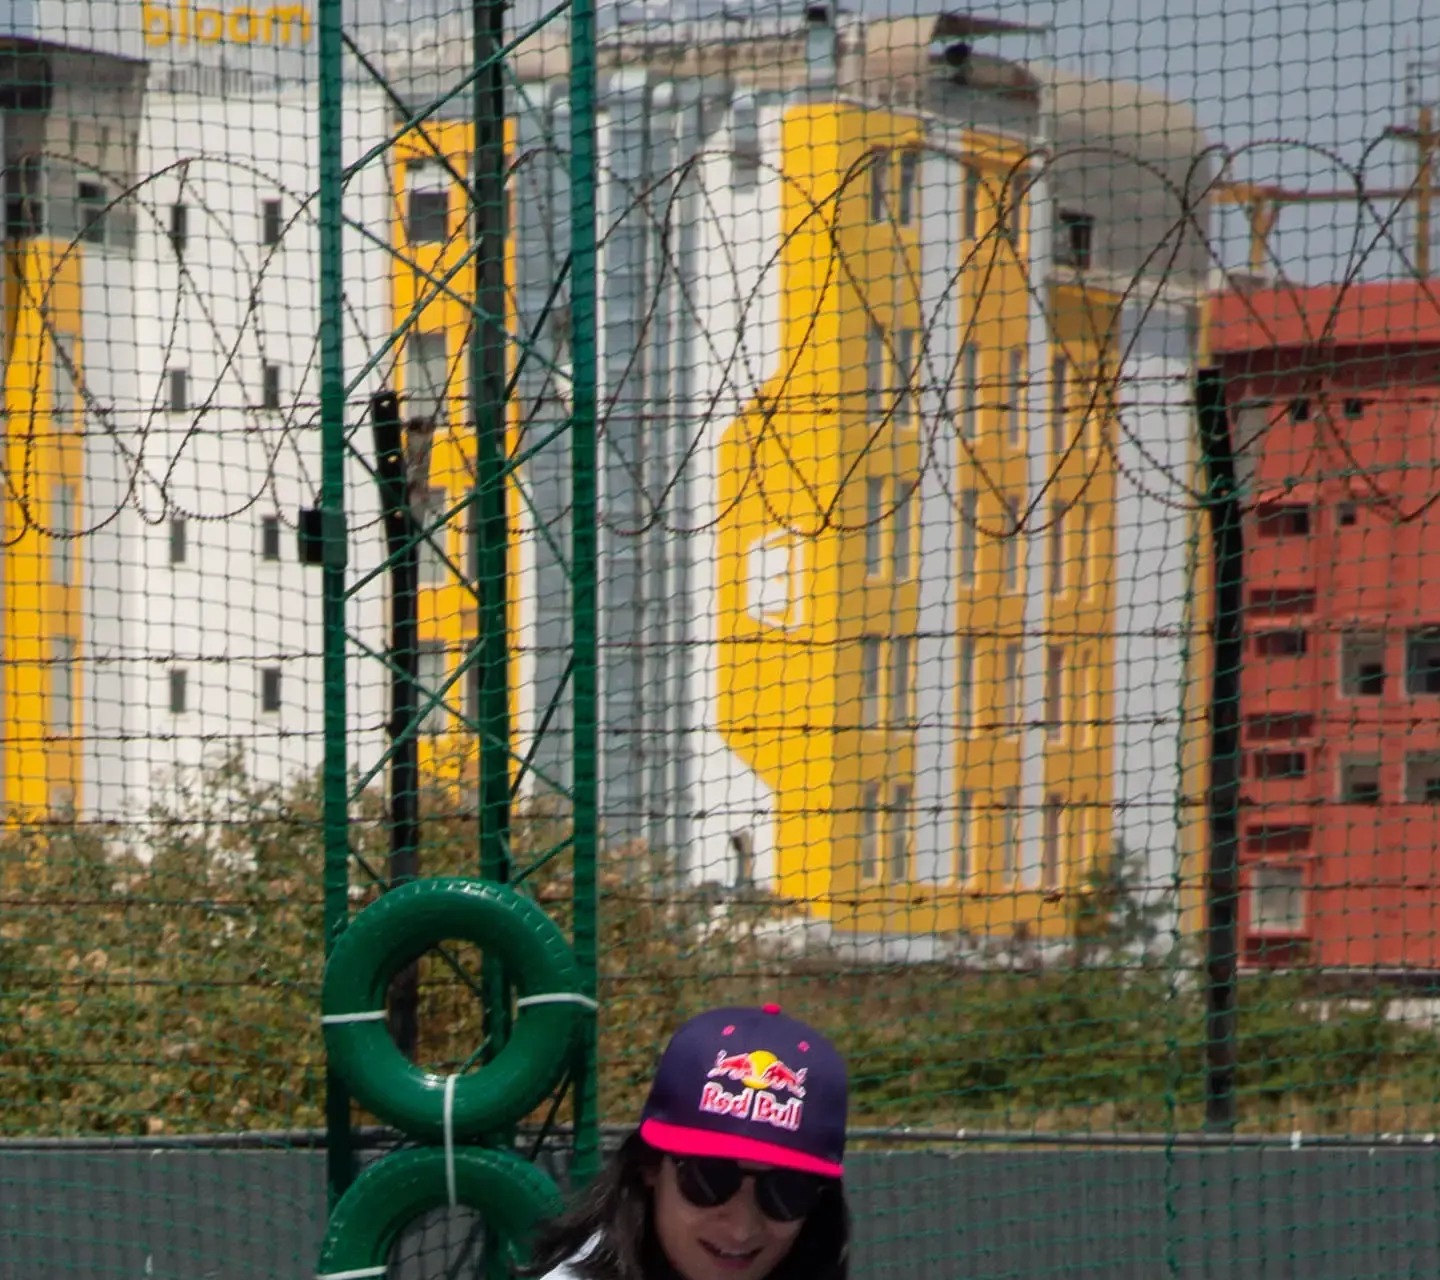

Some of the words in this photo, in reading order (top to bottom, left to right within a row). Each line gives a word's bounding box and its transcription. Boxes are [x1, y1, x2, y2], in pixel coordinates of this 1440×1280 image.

[143, 0, 312, 46] bloom
[699, 1080, 755, 1119] Red
[750, 1088, 804, 1132] Bull
